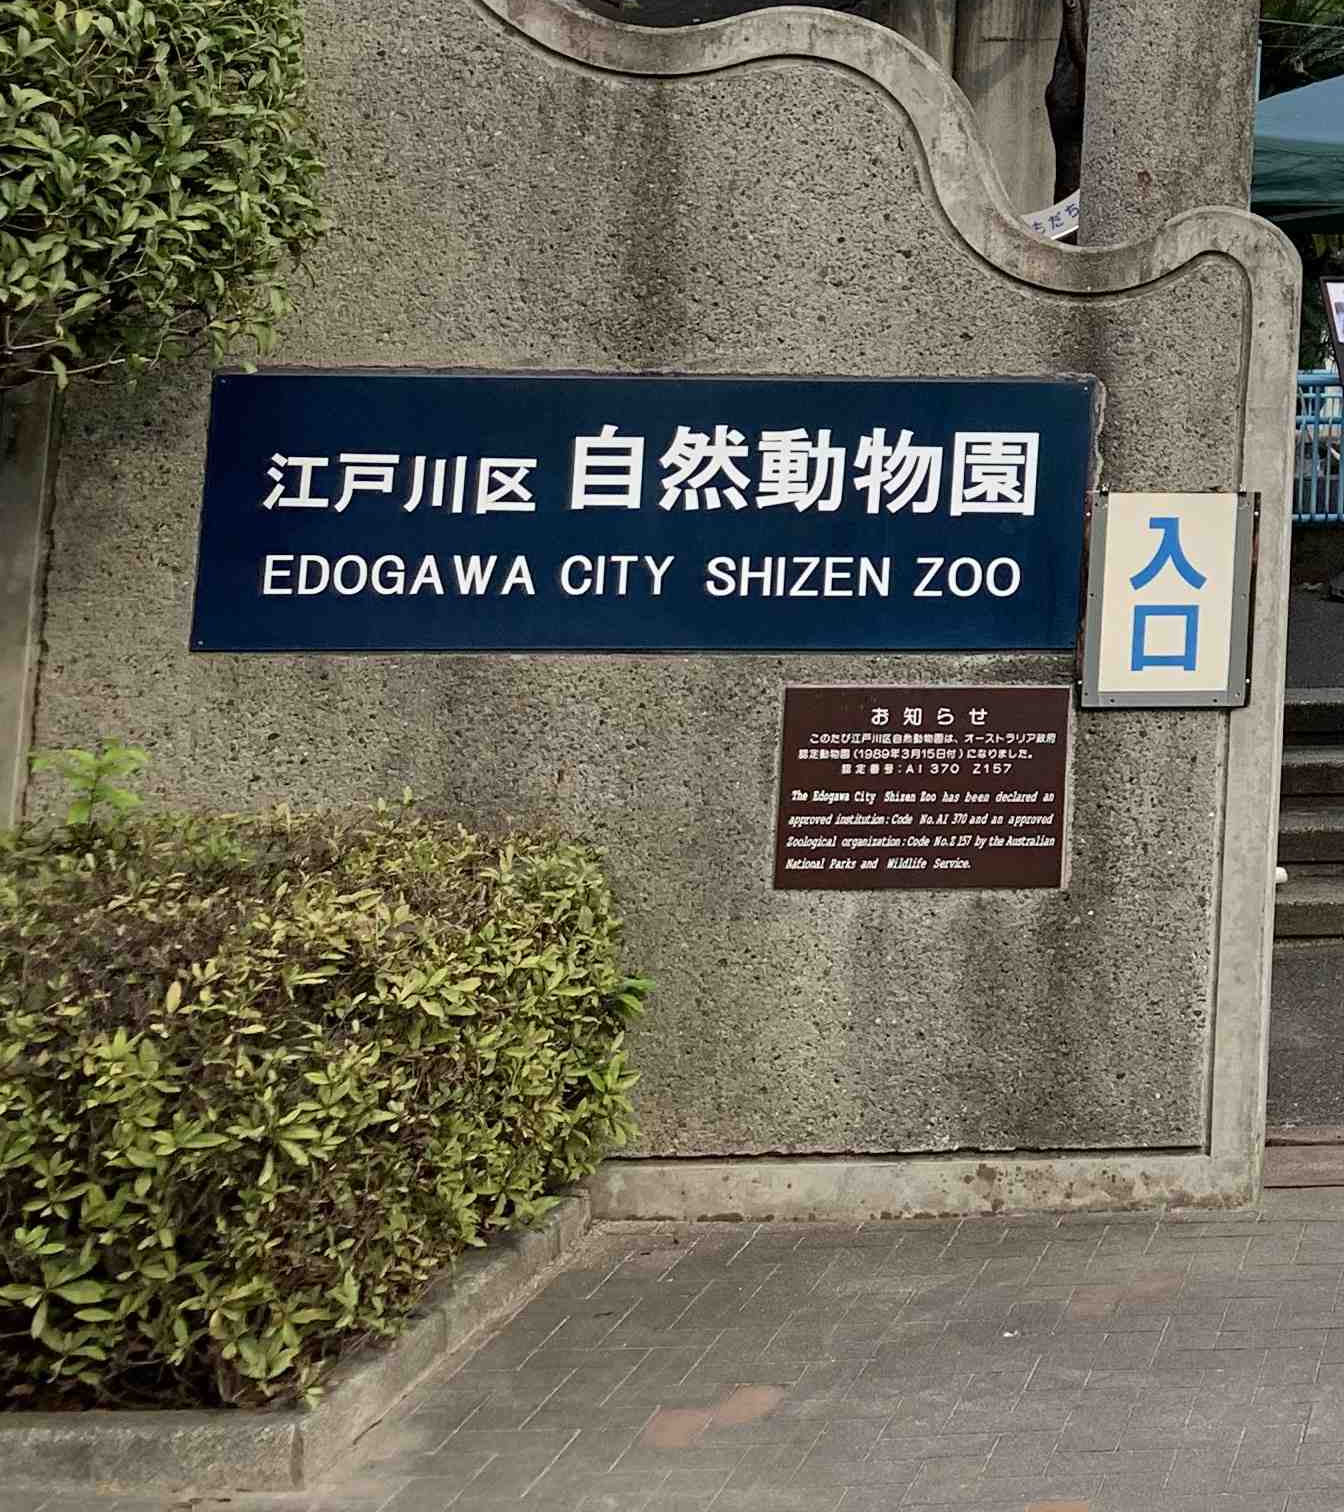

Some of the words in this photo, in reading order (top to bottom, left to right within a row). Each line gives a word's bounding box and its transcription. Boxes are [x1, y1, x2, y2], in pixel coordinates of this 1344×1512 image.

[262, 451, 537, 514] 江戸川区
[570, 424, 1040, 518] 自然動物園
[263, 553, 536, 596] EDOGAWA
[560, 554, 674, 596] CITY
[705, 555, 890, 597] SHIZEN
[914, 556, 1021, 598] ZOO
[1130, 517, 1207, 671] 入口
[871, 707, 988, 726] お知らせ
[972, 764, 1012, 774] Z157
[792, 790, 808, 801] The
[813, 790, 849, 805] Edogawa
[854, 791, 876, 805] City
[884, 791, 916, 803] Shizen
[920, 791, 936, 803] Zoo
[942, 791, 960, 803] has
[964, 791, 990, 803] been
[995, 791, 1038, 803] declared
[1042, 792, 1054, 802] an
[788, 813, 833, 828] approved
[969, 813, 988, 825] and
[991, 815, 1004, 824] an
[1008, 813, 1054, 828] approved
[786, 835, 837, 850] Zoological
[974, 834, 987, 849] by
[988, 835, 1005, 847] the
[1006, 835, 1055, 847] Australian
[785, 857, 826, 870] National
[829, 857, 856, 869] Parks
[860, 857, 879, 869] and
[887, 857, 927, 869] Wildlife
[932, 857, 971, 869] Service.
